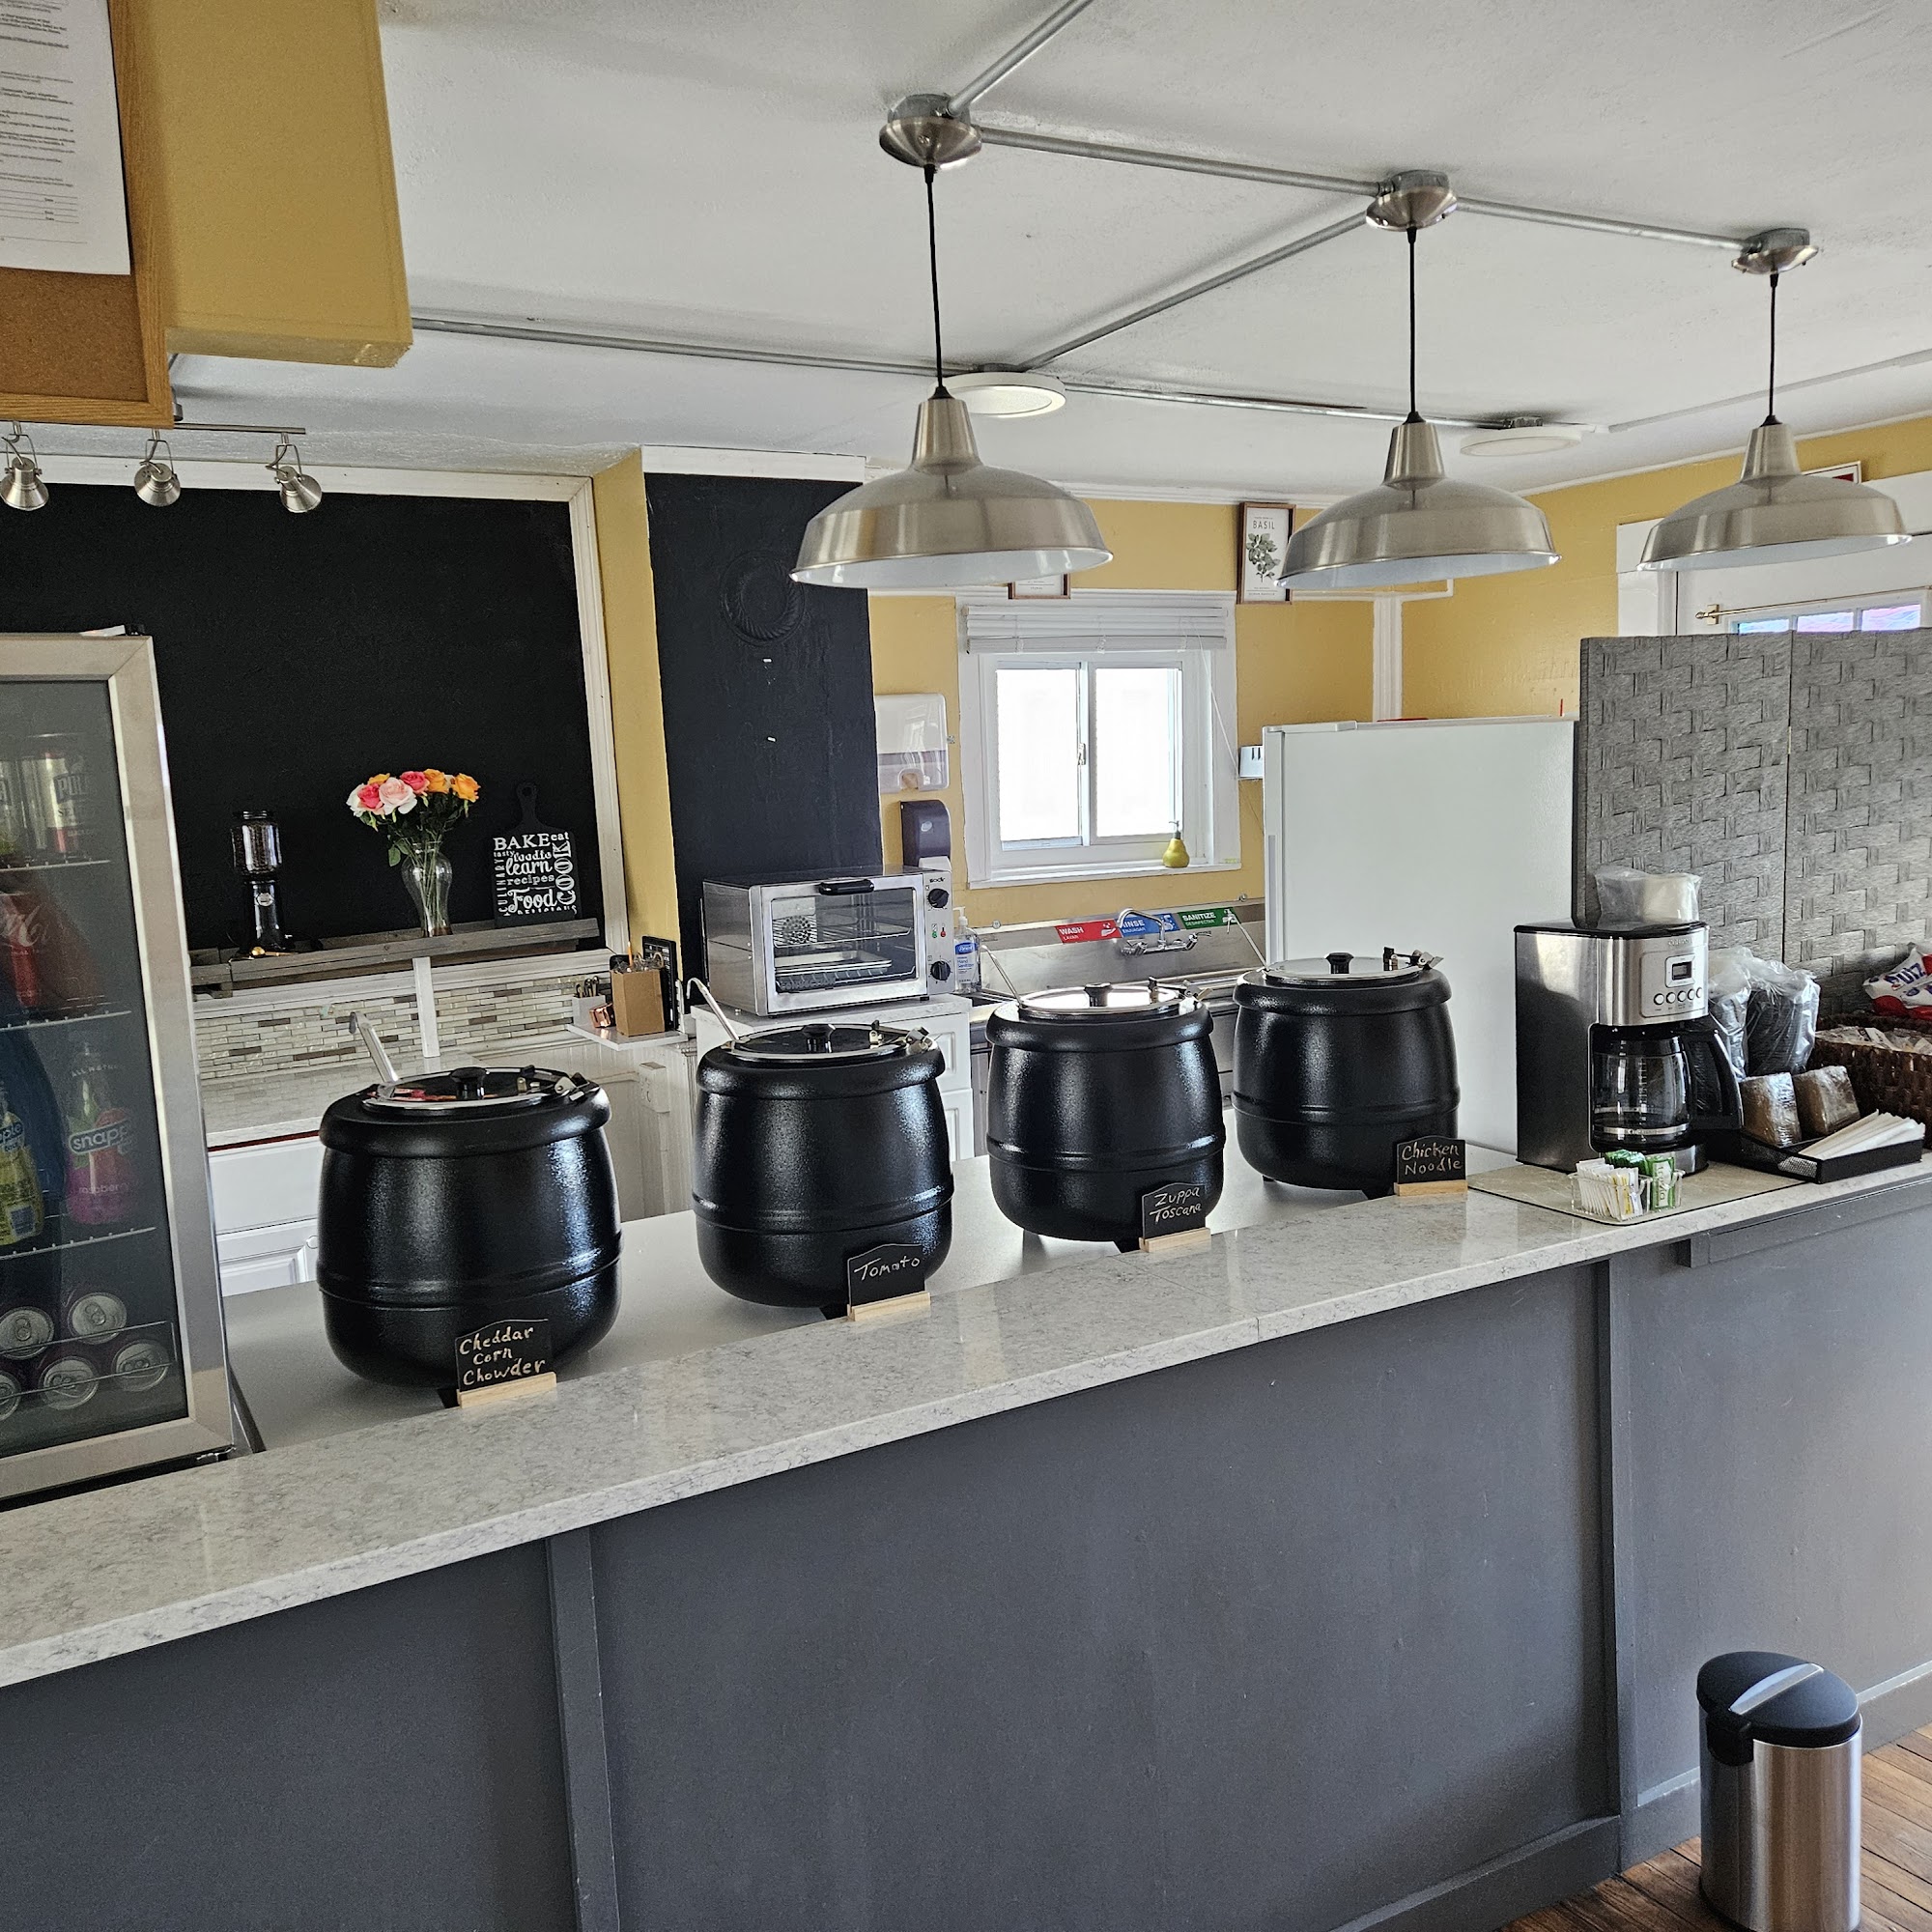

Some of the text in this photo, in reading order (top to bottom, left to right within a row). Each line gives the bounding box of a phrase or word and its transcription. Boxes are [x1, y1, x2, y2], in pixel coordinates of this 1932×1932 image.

[1252, 521, 1275, 529] BASIL
[493, 833, 551, 851] BAKE
[551, 831, 570, 841] eat
[505, 858, 553, 876] learn
[552, 840, 577, 905] COOK
[494, 859, 509, 913] CULINARY
[506, 874, 554, 886] recipes
[507, 886, 557, 913] Food
[1182, 912, 1216, 922] SANITIZE
[1059, 926, 1085, 935] WASH
[1402, 1141, 1460, 1160] Chicken
[1405, 1156, 1463, 1176] Noodle
[1154, 1186, 1201, 1208] Zuppa
[1149, 1202, 1202, 1224] Toscana
[853, 1255, 921, 1281] Tomato
[459, 1325, 534, 1354] Cheddar
[472, 1347, 513, 1366] Corn
[463, 1357, 546, 1385] Chowder
